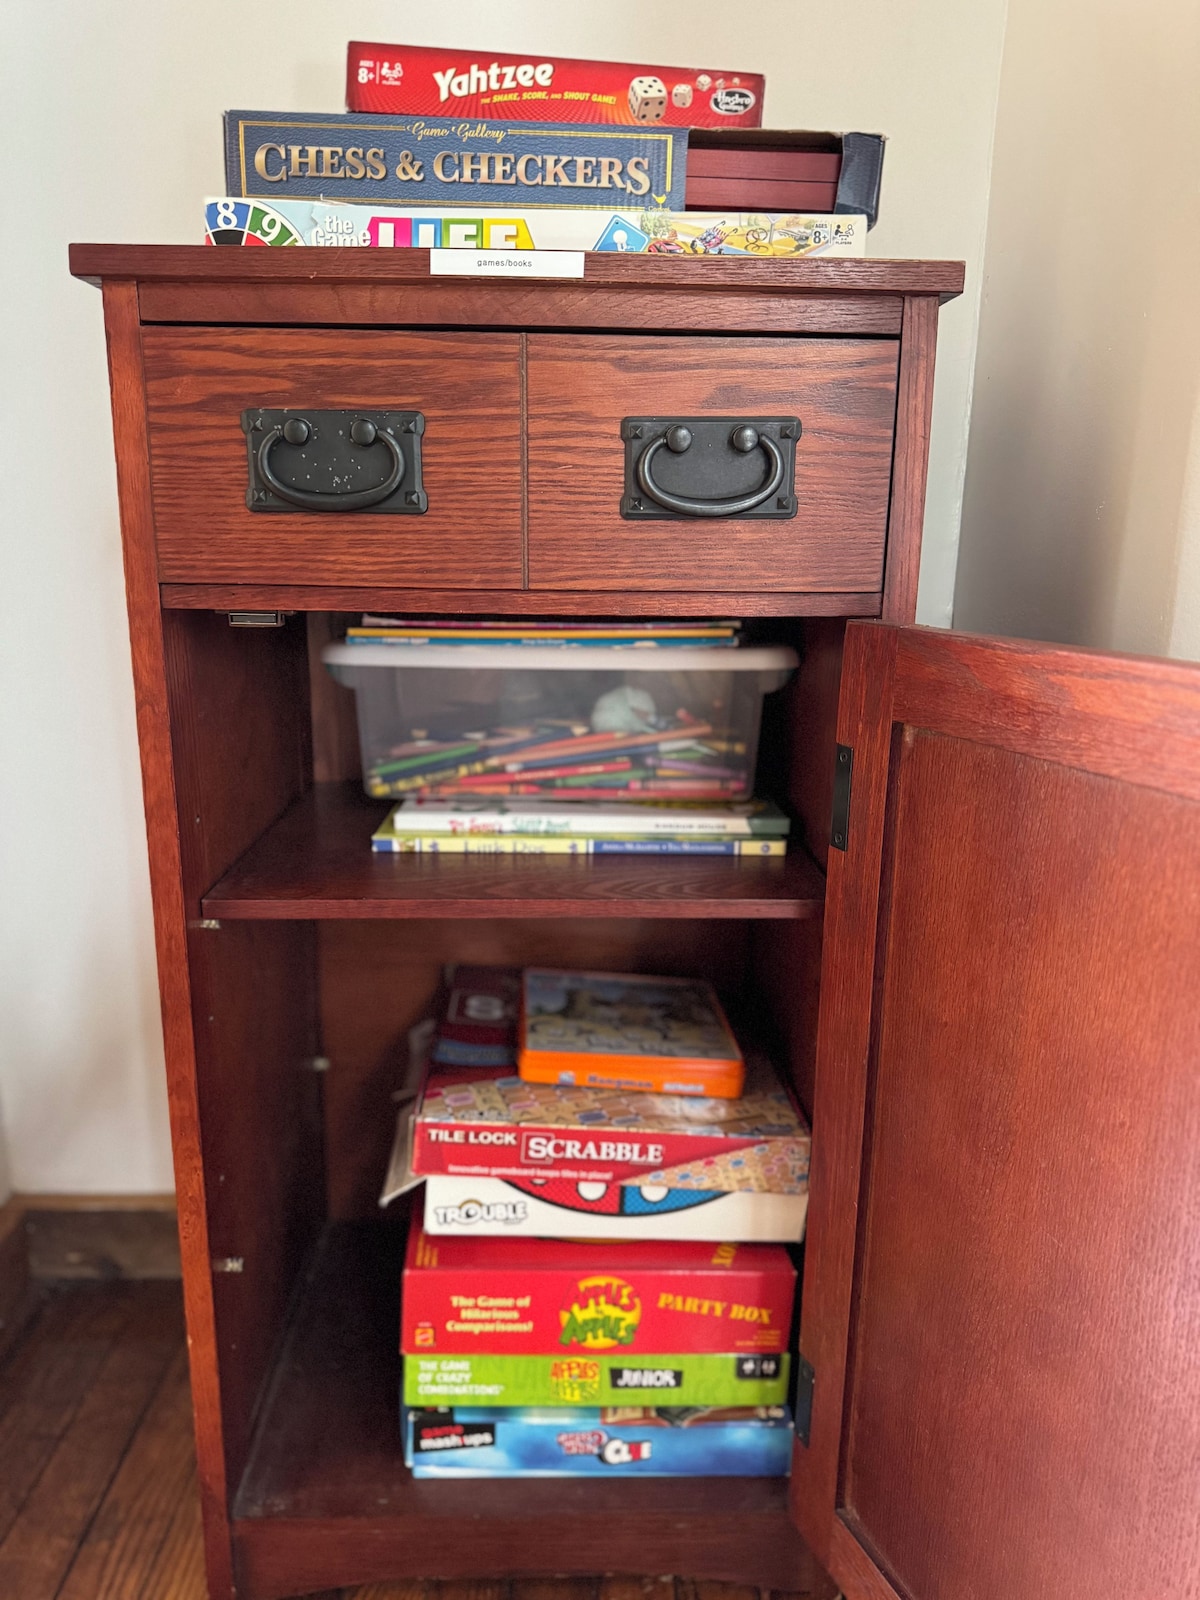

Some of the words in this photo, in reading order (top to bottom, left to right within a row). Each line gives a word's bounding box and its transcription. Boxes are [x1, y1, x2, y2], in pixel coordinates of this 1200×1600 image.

[358, 67, 375, 84] 8+
[433, 63, 554, 103] Yahtzee
[522, 91, 549, 100] SCORE,
[564, 91, 590, 101] SHOUT
[592, 94, 617, 105] GAME!
[406, 121, 449, 141] Game
[451, 122, 507, 144] Gallery
[254, 142, 387, 183] CHESS
[395, 150, 424, 182] &
[433, 151, 650, 196] CHECKERS
[216, 200, 238, 229] 8
[324, 215, 354, 234] the
[255, 213, 282, 241] 9
[310, 227, 372, 247] Game
[813, 230, 828, 244] 8+
[477, 258, 533, 268] games/books
[428, 1129, 466, 1143] TILE
[468, 1131, 517, 1146] LOCK
[528, 1136, 664, 1164] SCRABBLE
[434, 1201, 528, 1226] TROUBLE
[451, 1296, 475, 1307] The
[477, 1295, 514, 1307] Game
[516, 1295, 531, 1307] of
[657, 1293, 727, 1318] PARTY
[729, 1303, 772, 1325] BOX
[617, 1368, 676, 1387] JUNIOR
